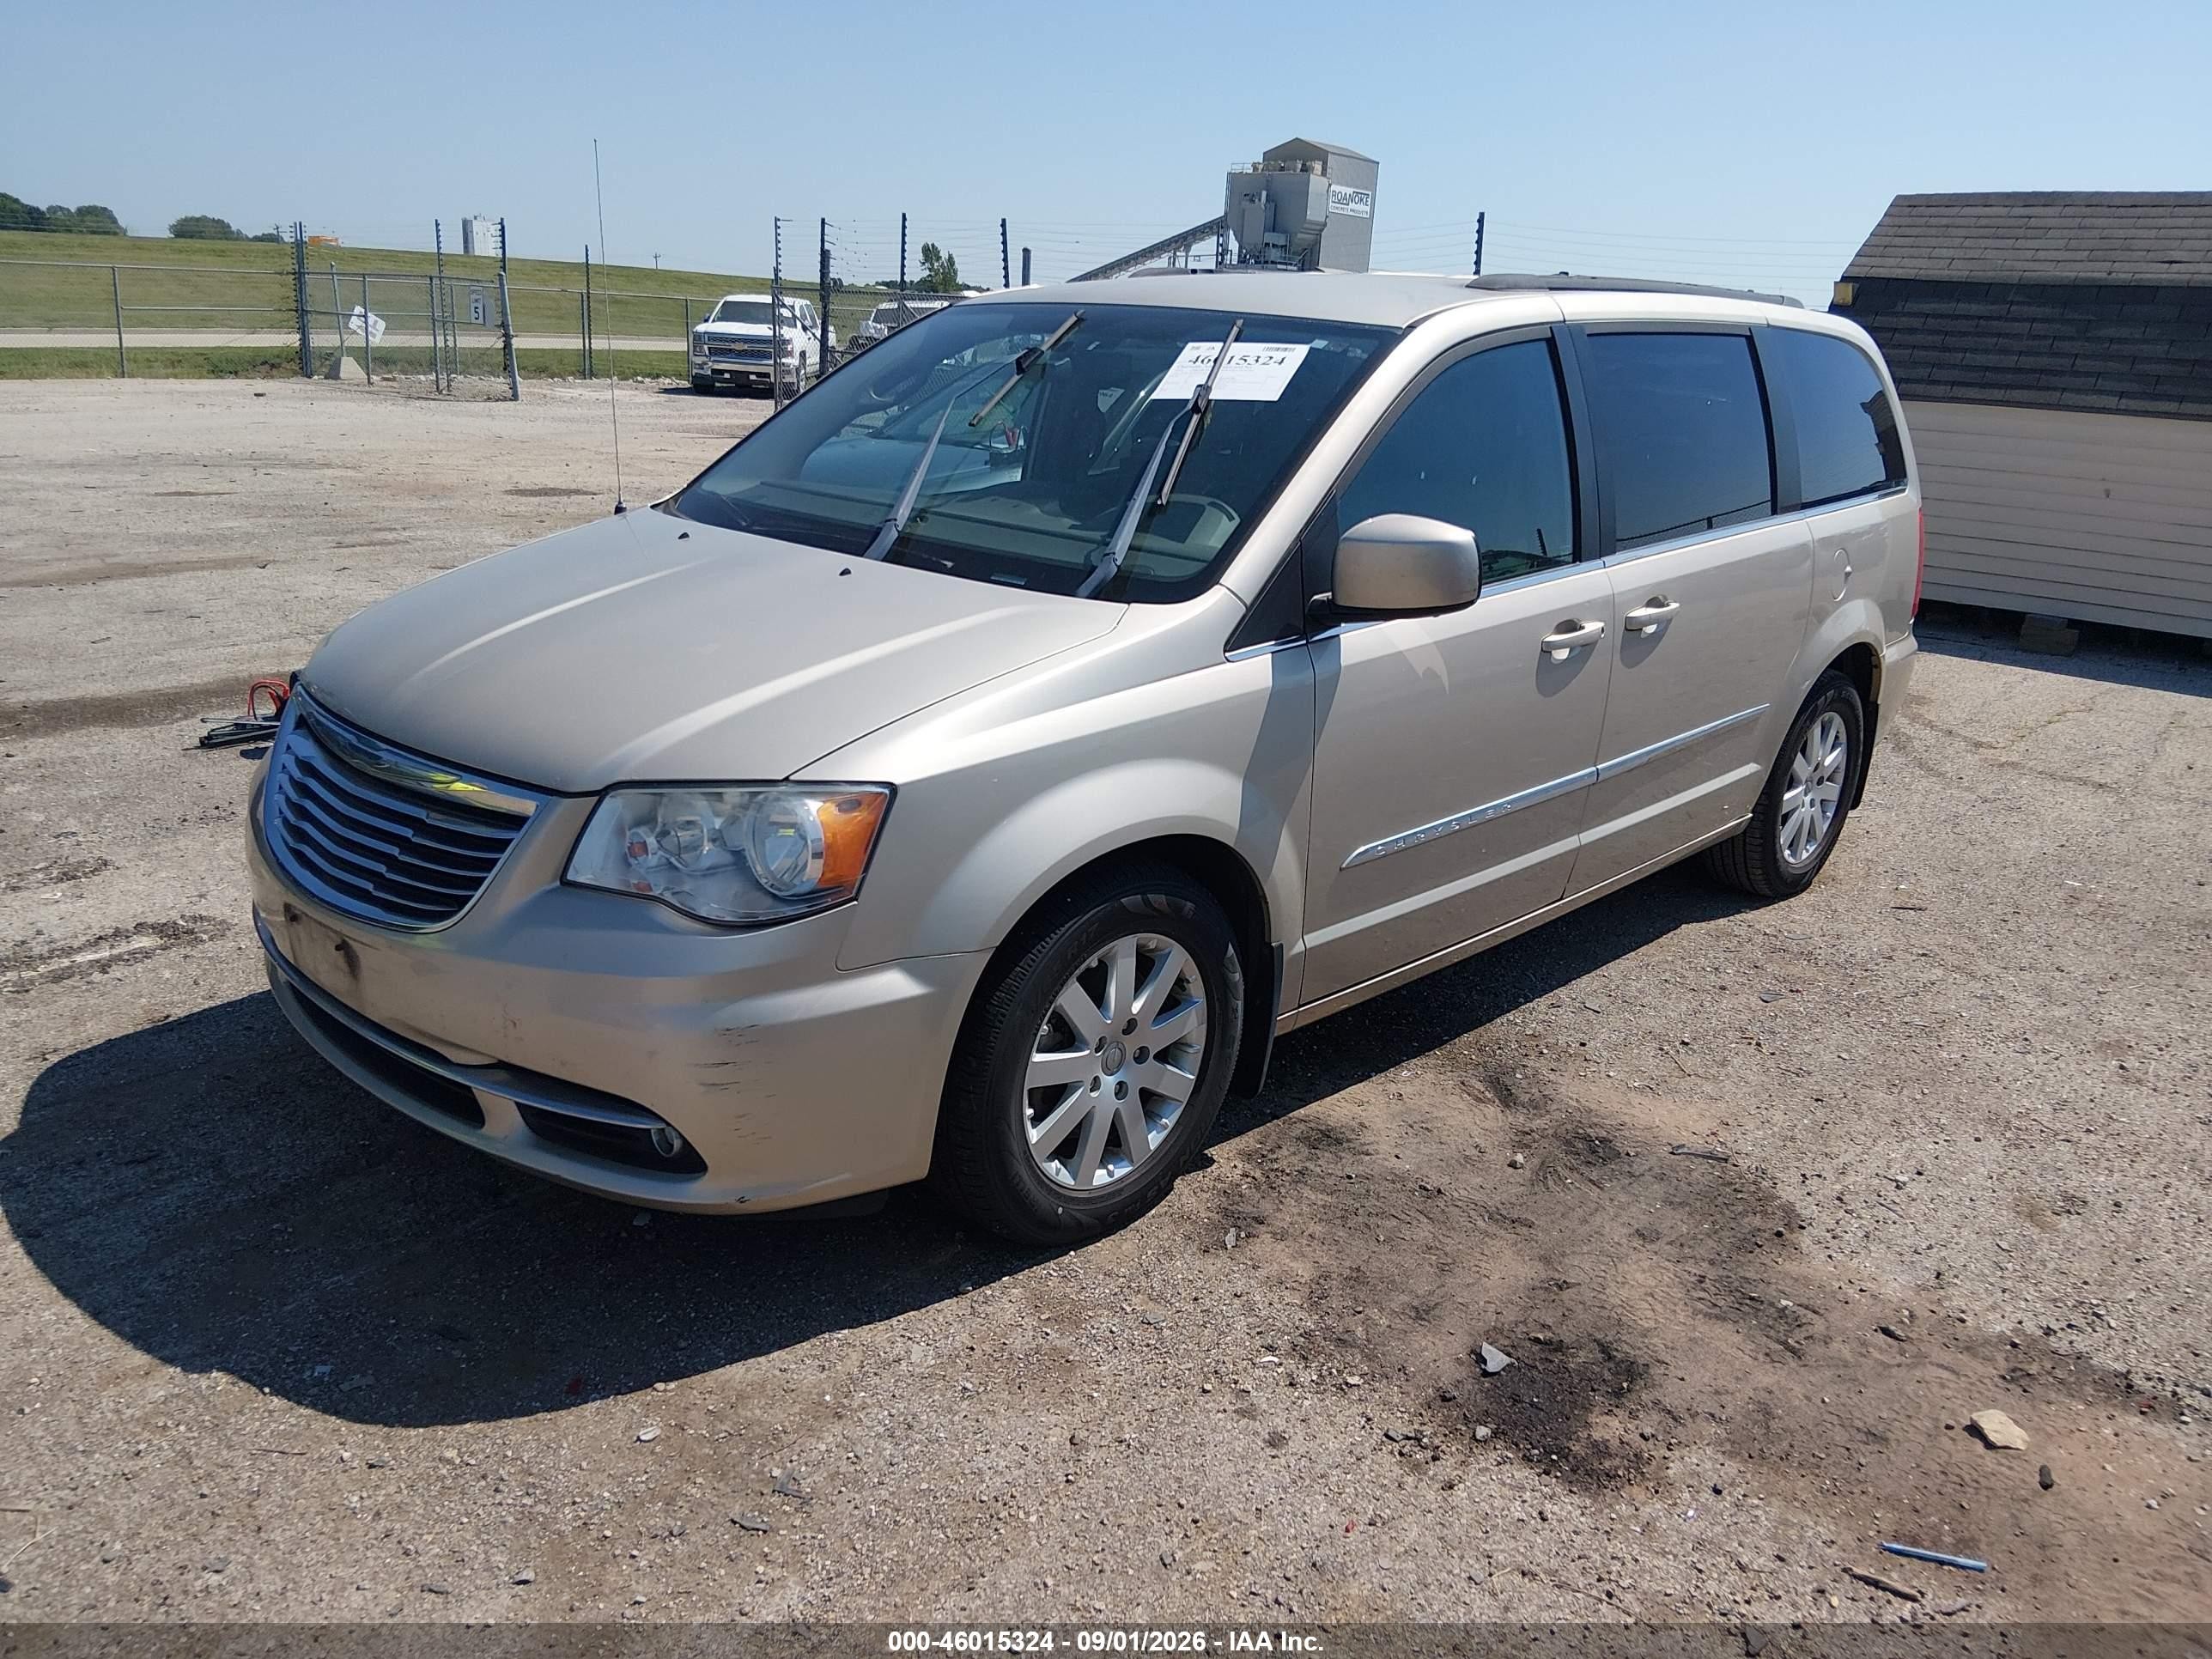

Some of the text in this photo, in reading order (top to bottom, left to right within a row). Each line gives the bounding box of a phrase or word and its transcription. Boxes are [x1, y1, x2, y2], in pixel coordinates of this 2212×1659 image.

[1331, 190, 1370, 207] ROANOKE
[1330, 204, 1349, 213] CONCRETE
[474, 307, 480, 320] 5
[1374, 803, 1512, 856] CHRYSLER
